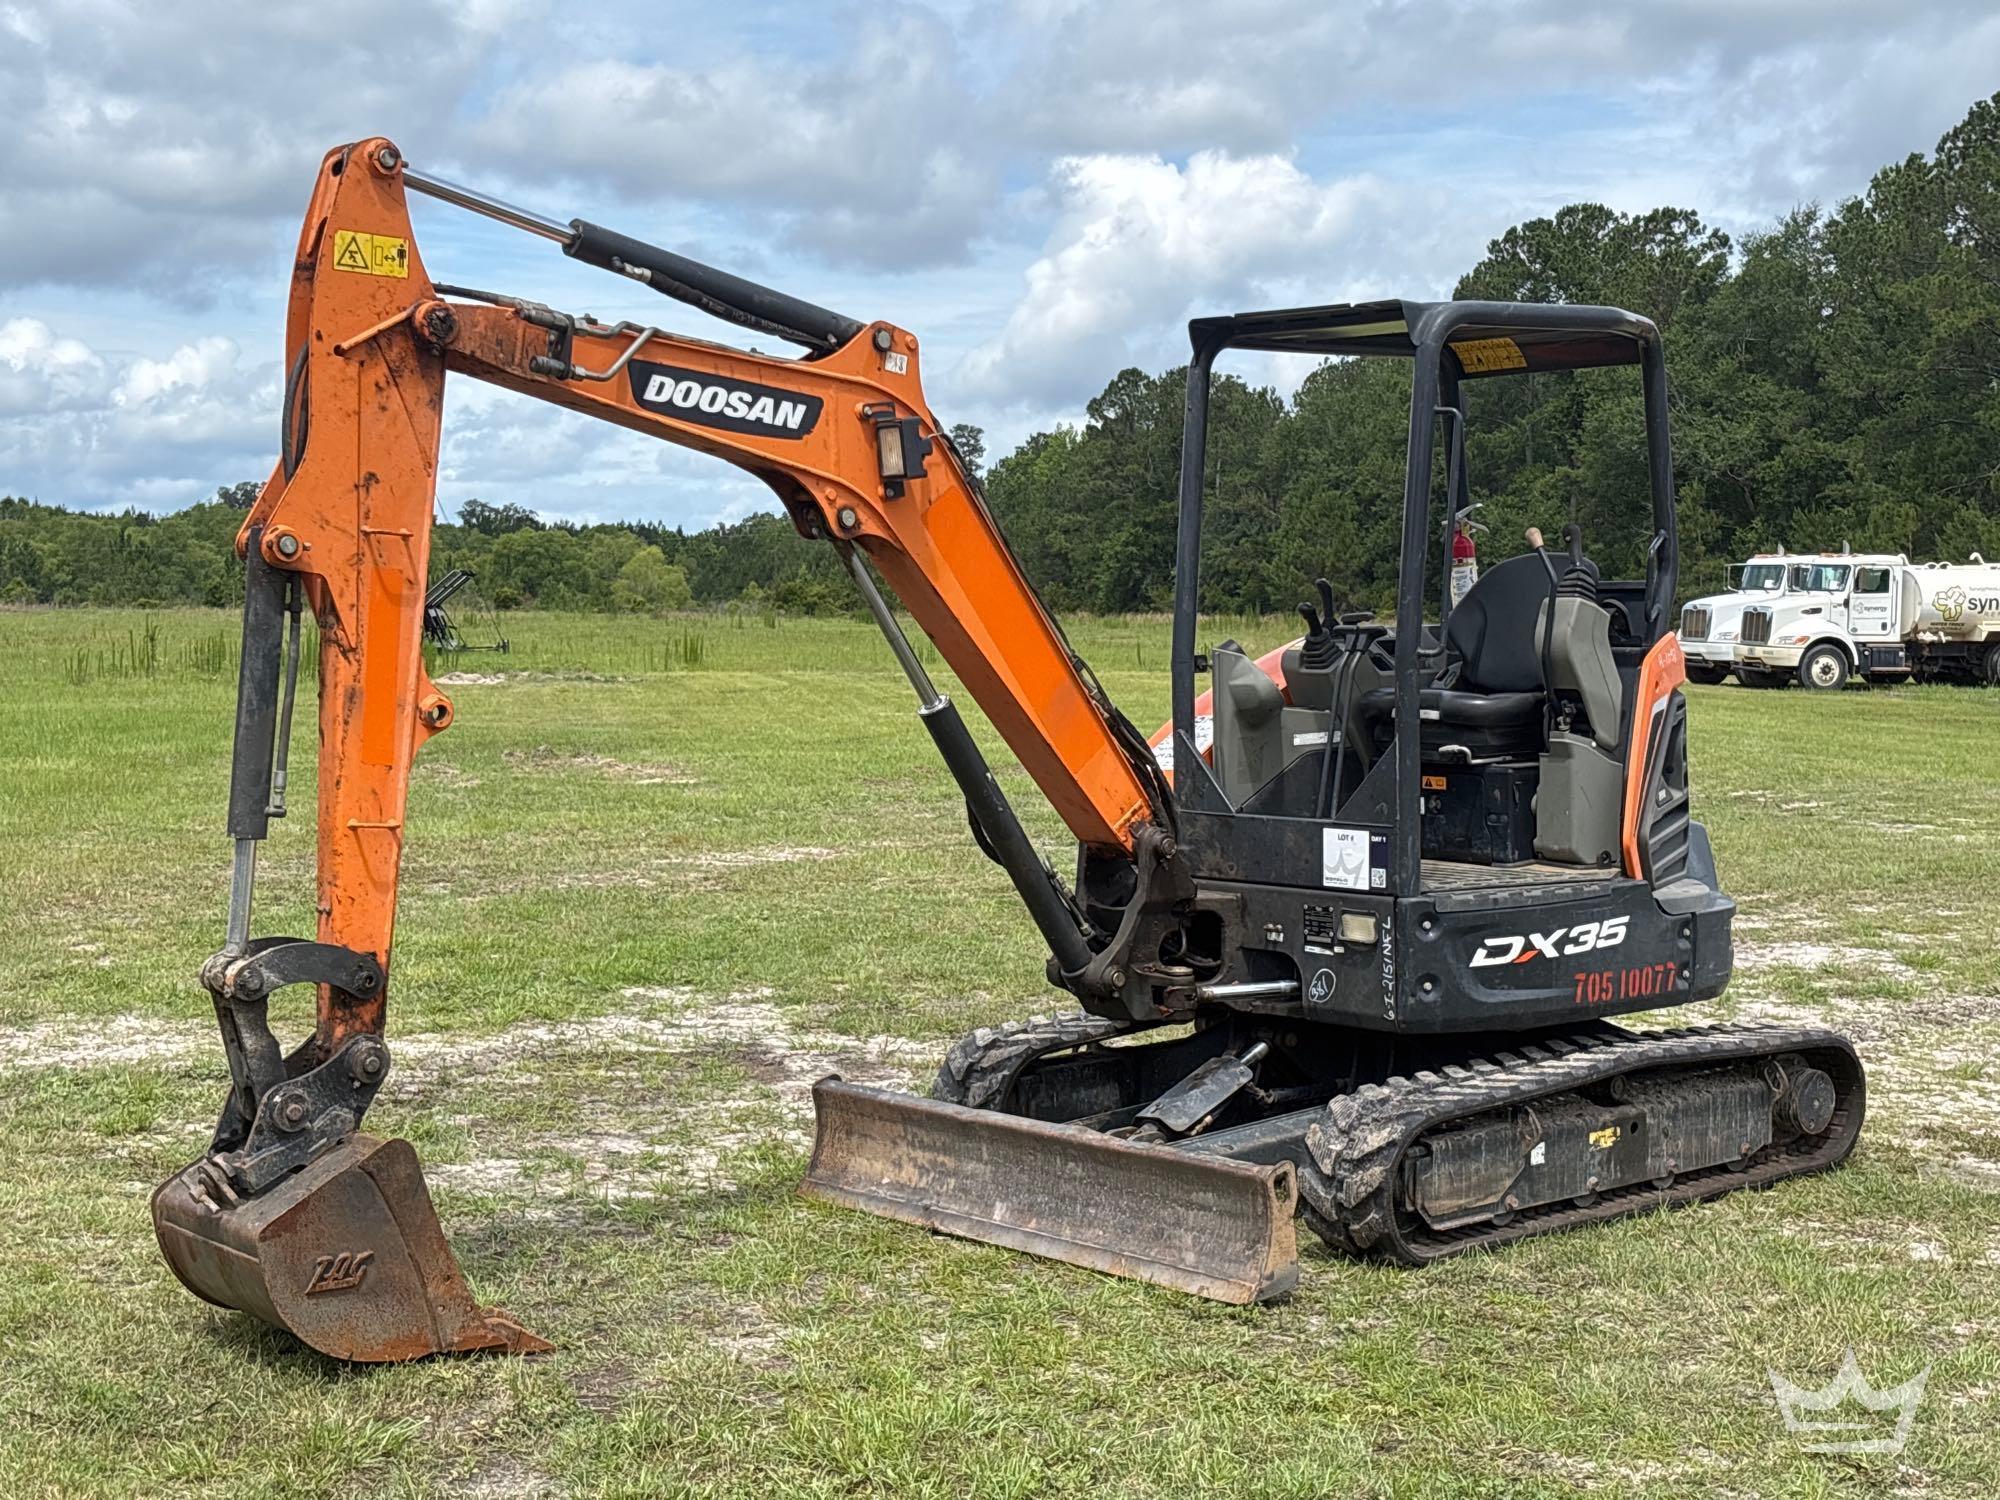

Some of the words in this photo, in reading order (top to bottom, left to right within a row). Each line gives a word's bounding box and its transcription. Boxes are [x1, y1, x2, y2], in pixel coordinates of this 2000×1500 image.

[643, 374, 807, 430] DOOSAN
[1337, 834, 1349, 842] LOT
[1469, 915, 1630, 967] DX35
